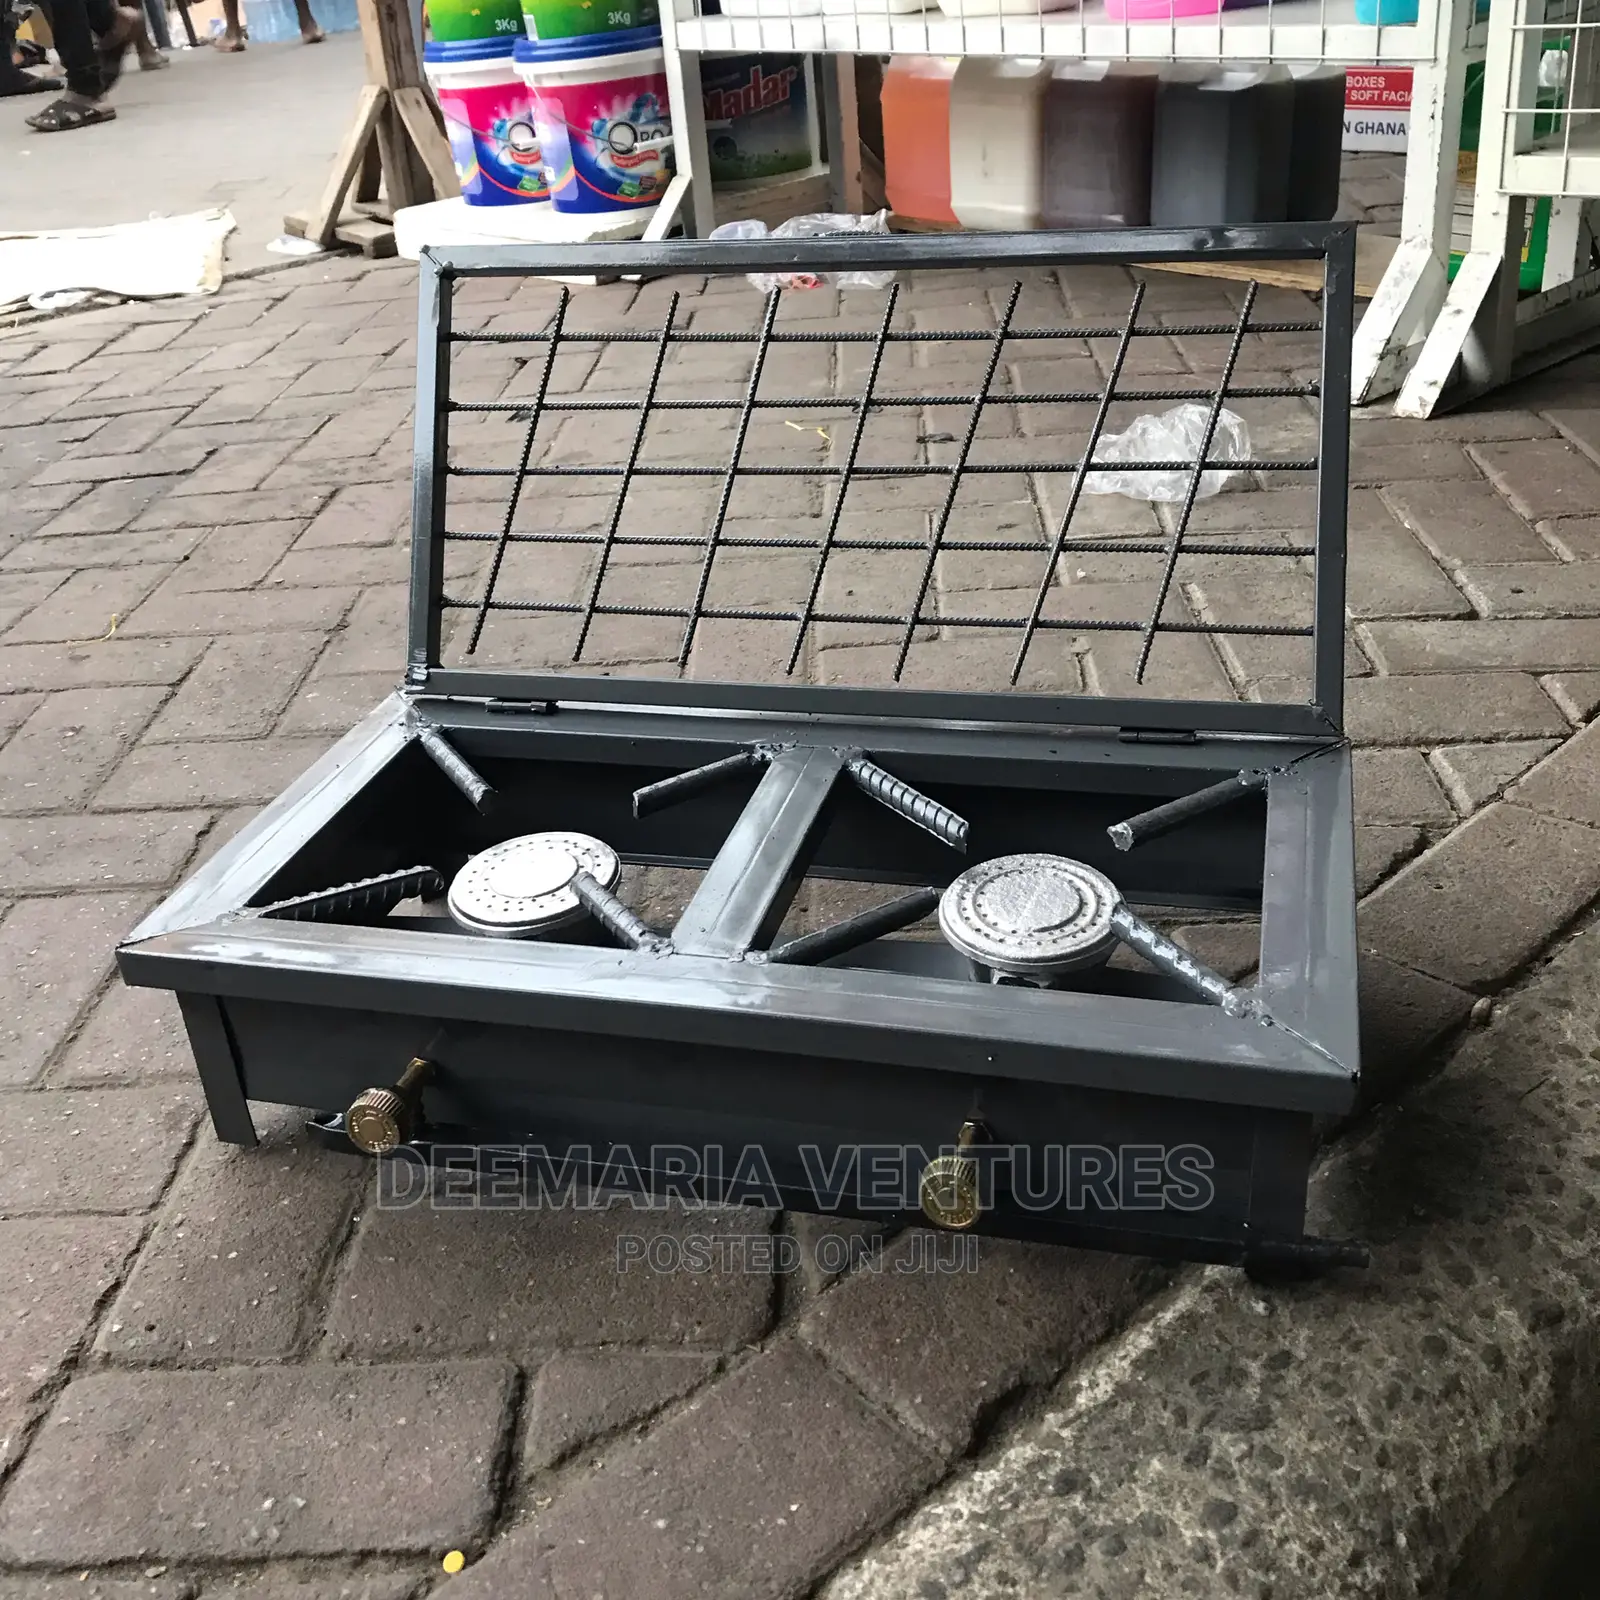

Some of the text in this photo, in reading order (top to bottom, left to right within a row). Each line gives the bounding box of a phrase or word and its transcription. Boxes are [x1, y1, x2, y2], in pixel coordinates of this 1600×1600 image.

[608, 11, 631, 25] 3Kg
[495, 19, 518, 32] 3Kg
[1350, 90, 1380, 101] SOFT
[1354, 121, 1406, 136] GHANA
